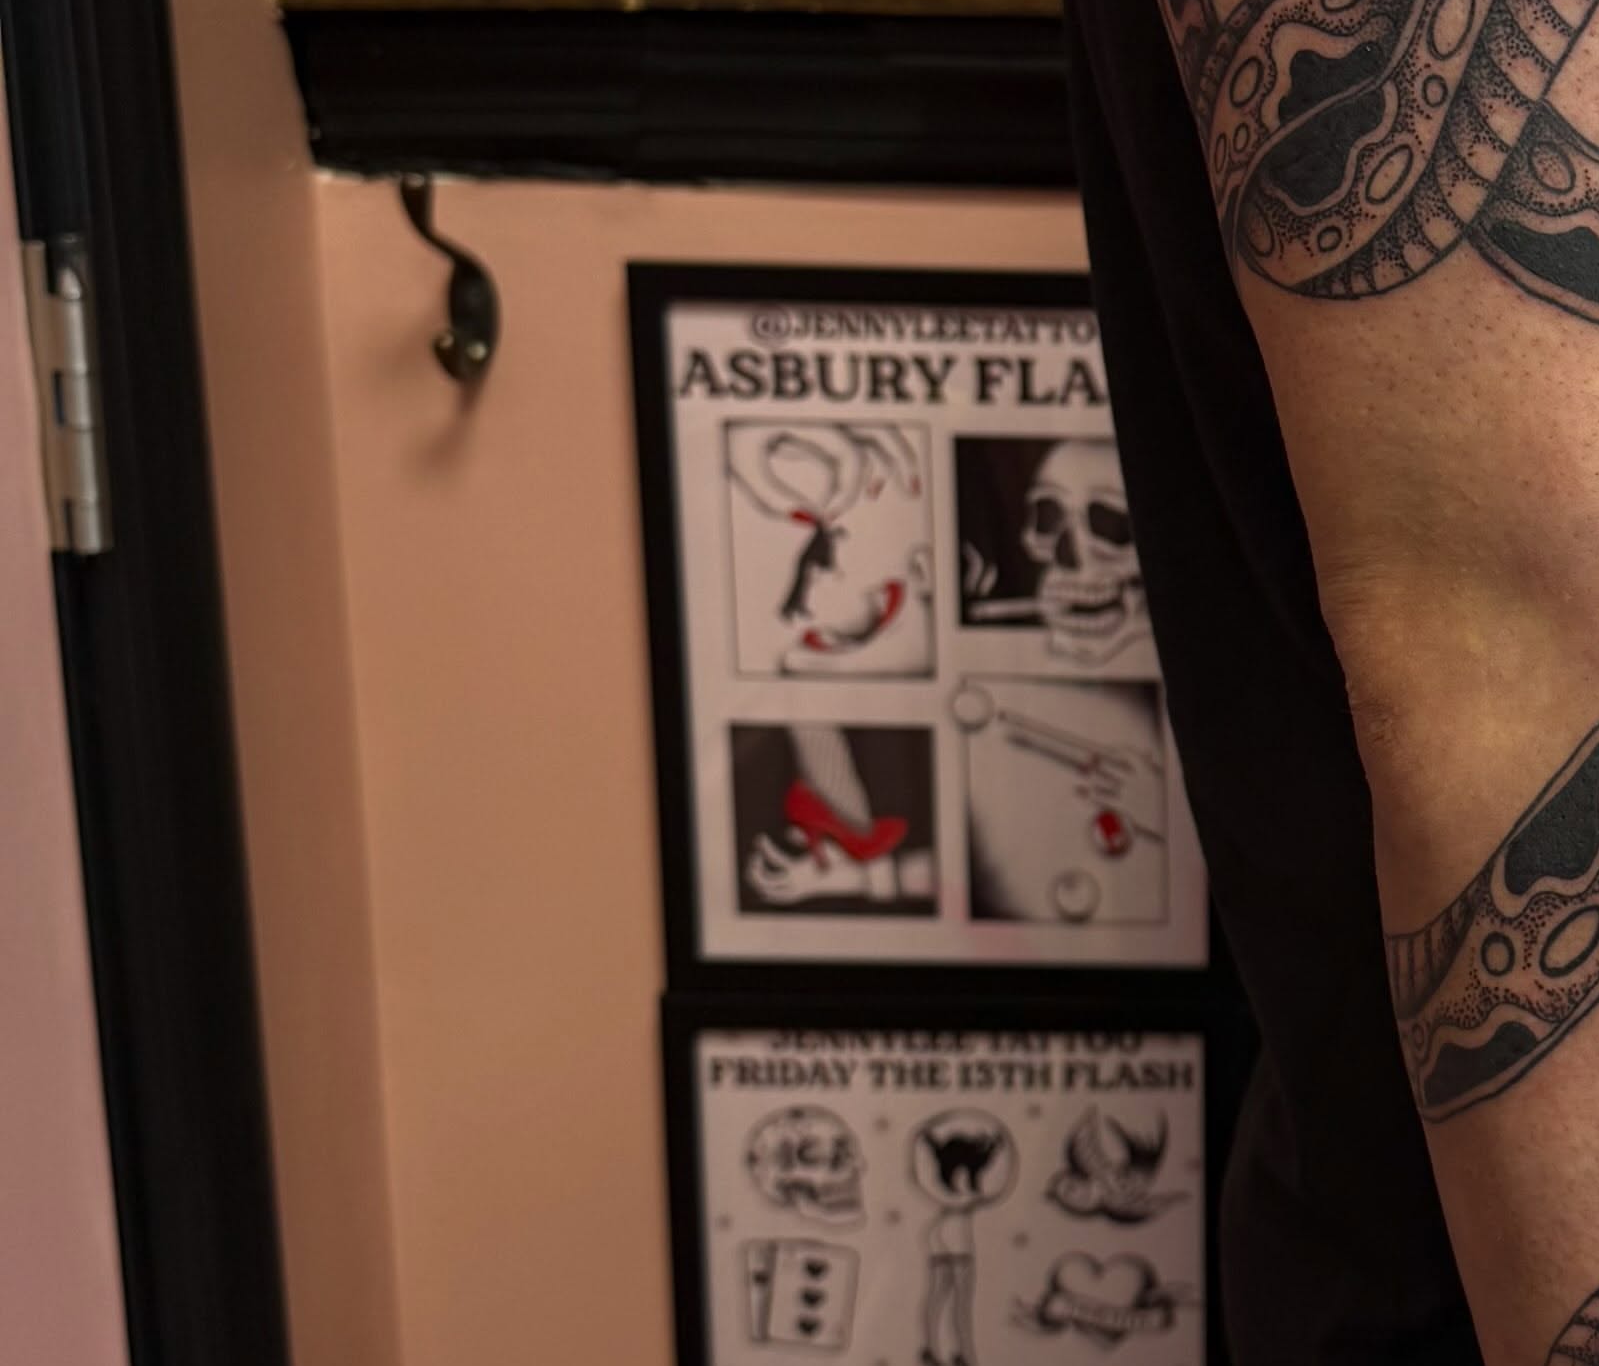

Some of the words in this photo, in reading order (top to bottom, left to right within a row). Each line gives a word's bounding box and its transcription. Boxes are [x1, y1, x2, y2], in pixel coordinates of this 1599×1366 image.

[680, 348, 955, 404] ASBURY
[710, 1056, 856, 1089] FRIDAY
[868, 1057, 950, 1089] THE
[1064, 1059, 1194, 1092] FLASH
